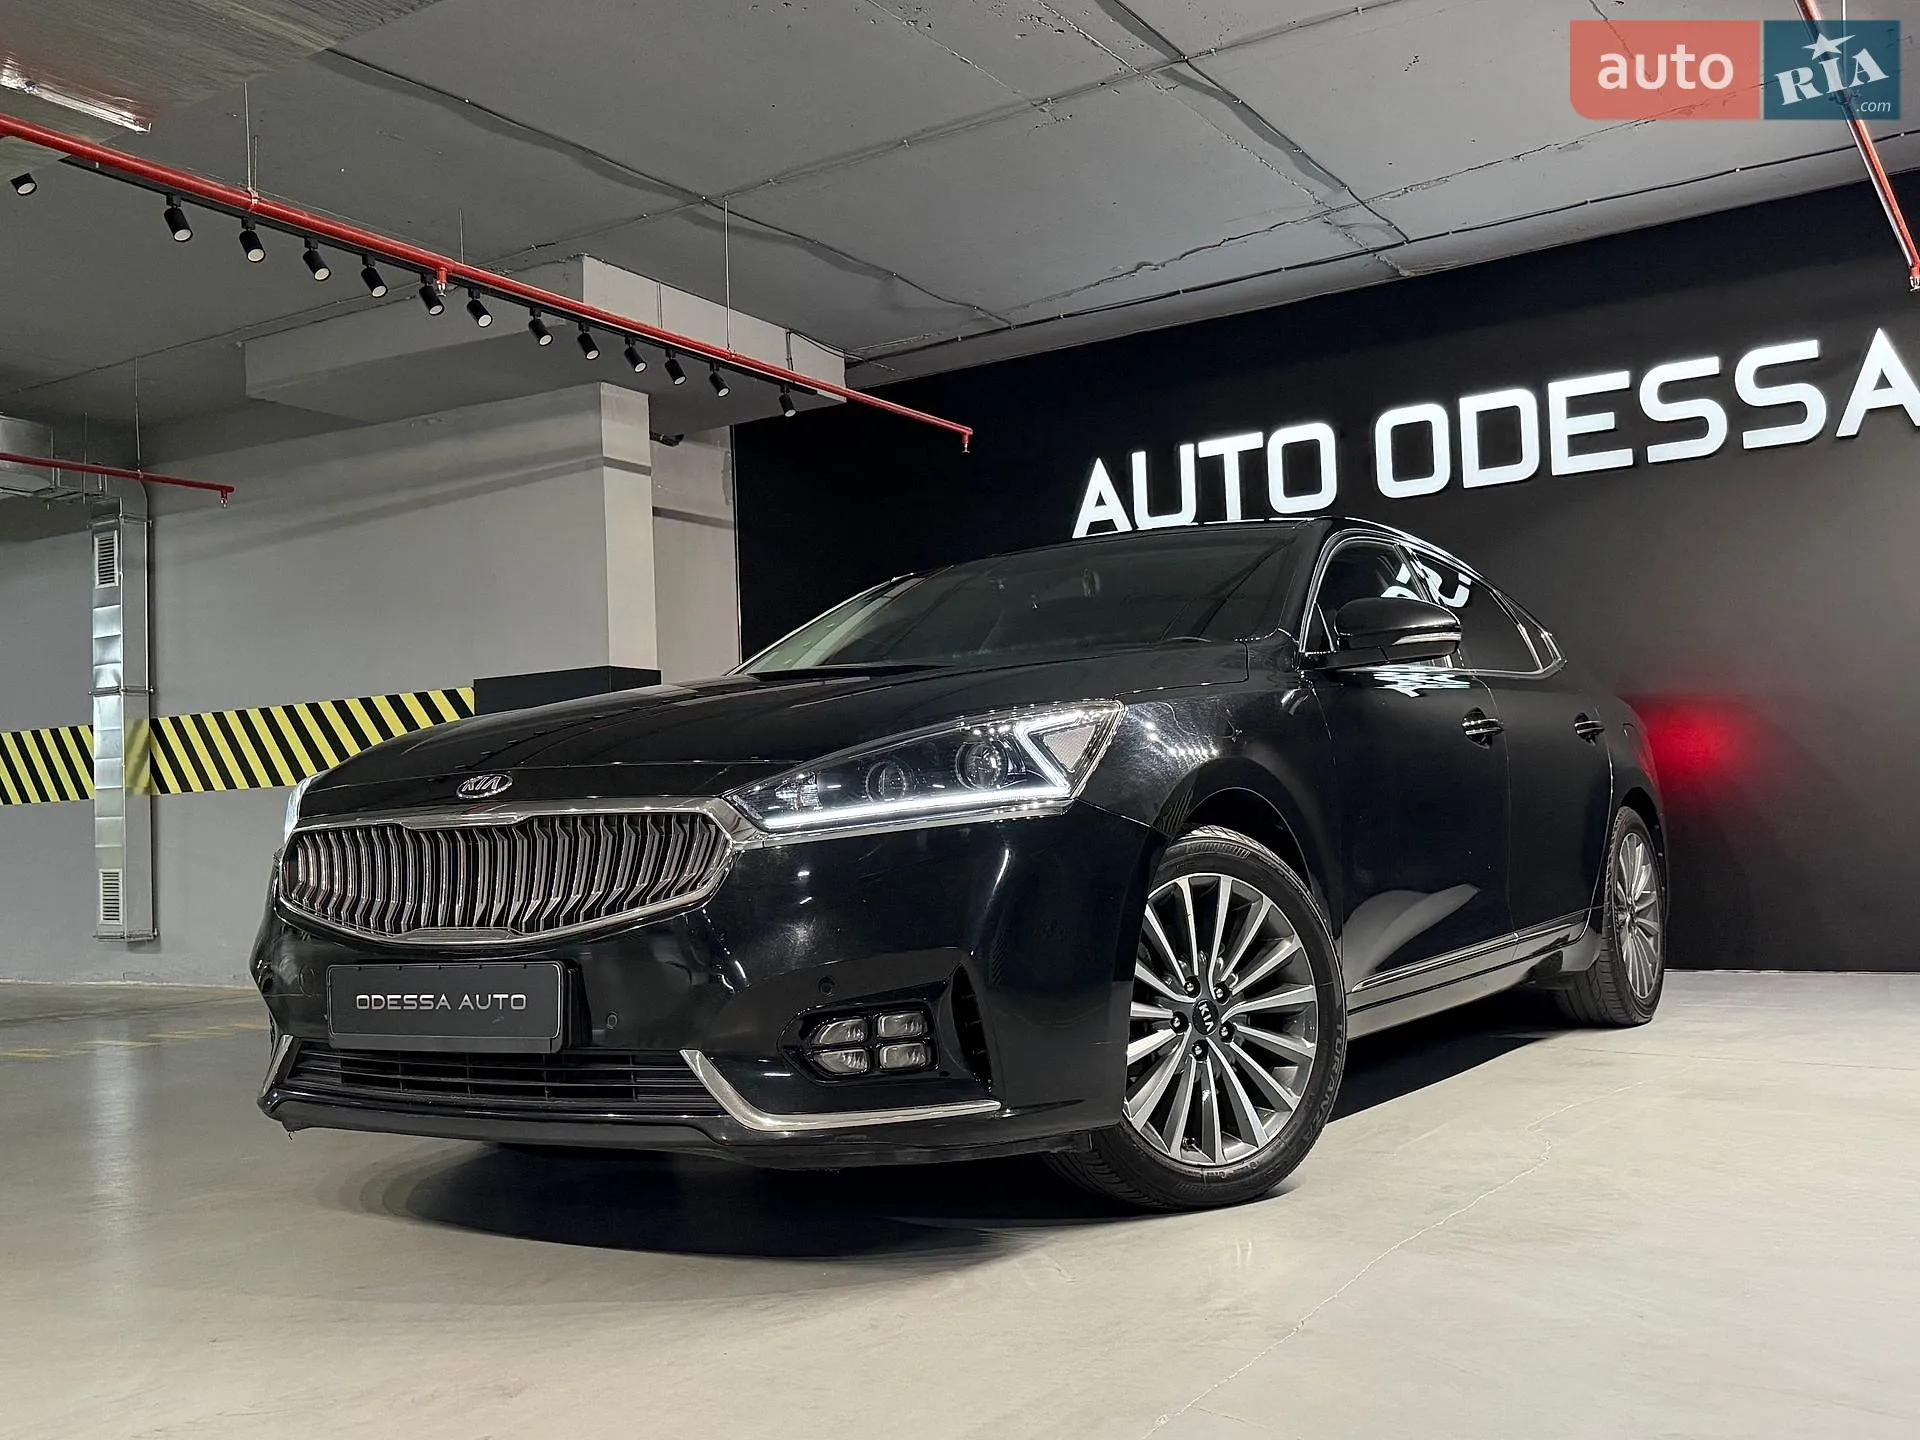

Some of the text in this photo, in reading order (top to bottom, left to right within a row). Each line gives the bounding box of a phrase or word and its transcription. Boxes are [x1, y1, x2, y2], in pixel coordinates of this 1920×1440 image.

[1072, 327, 1920, 539] AUTO ODESSA
[356, 993, 527, 1011] ODESSA AUTO
[1198, 1002, 1215, 1033] KIA
